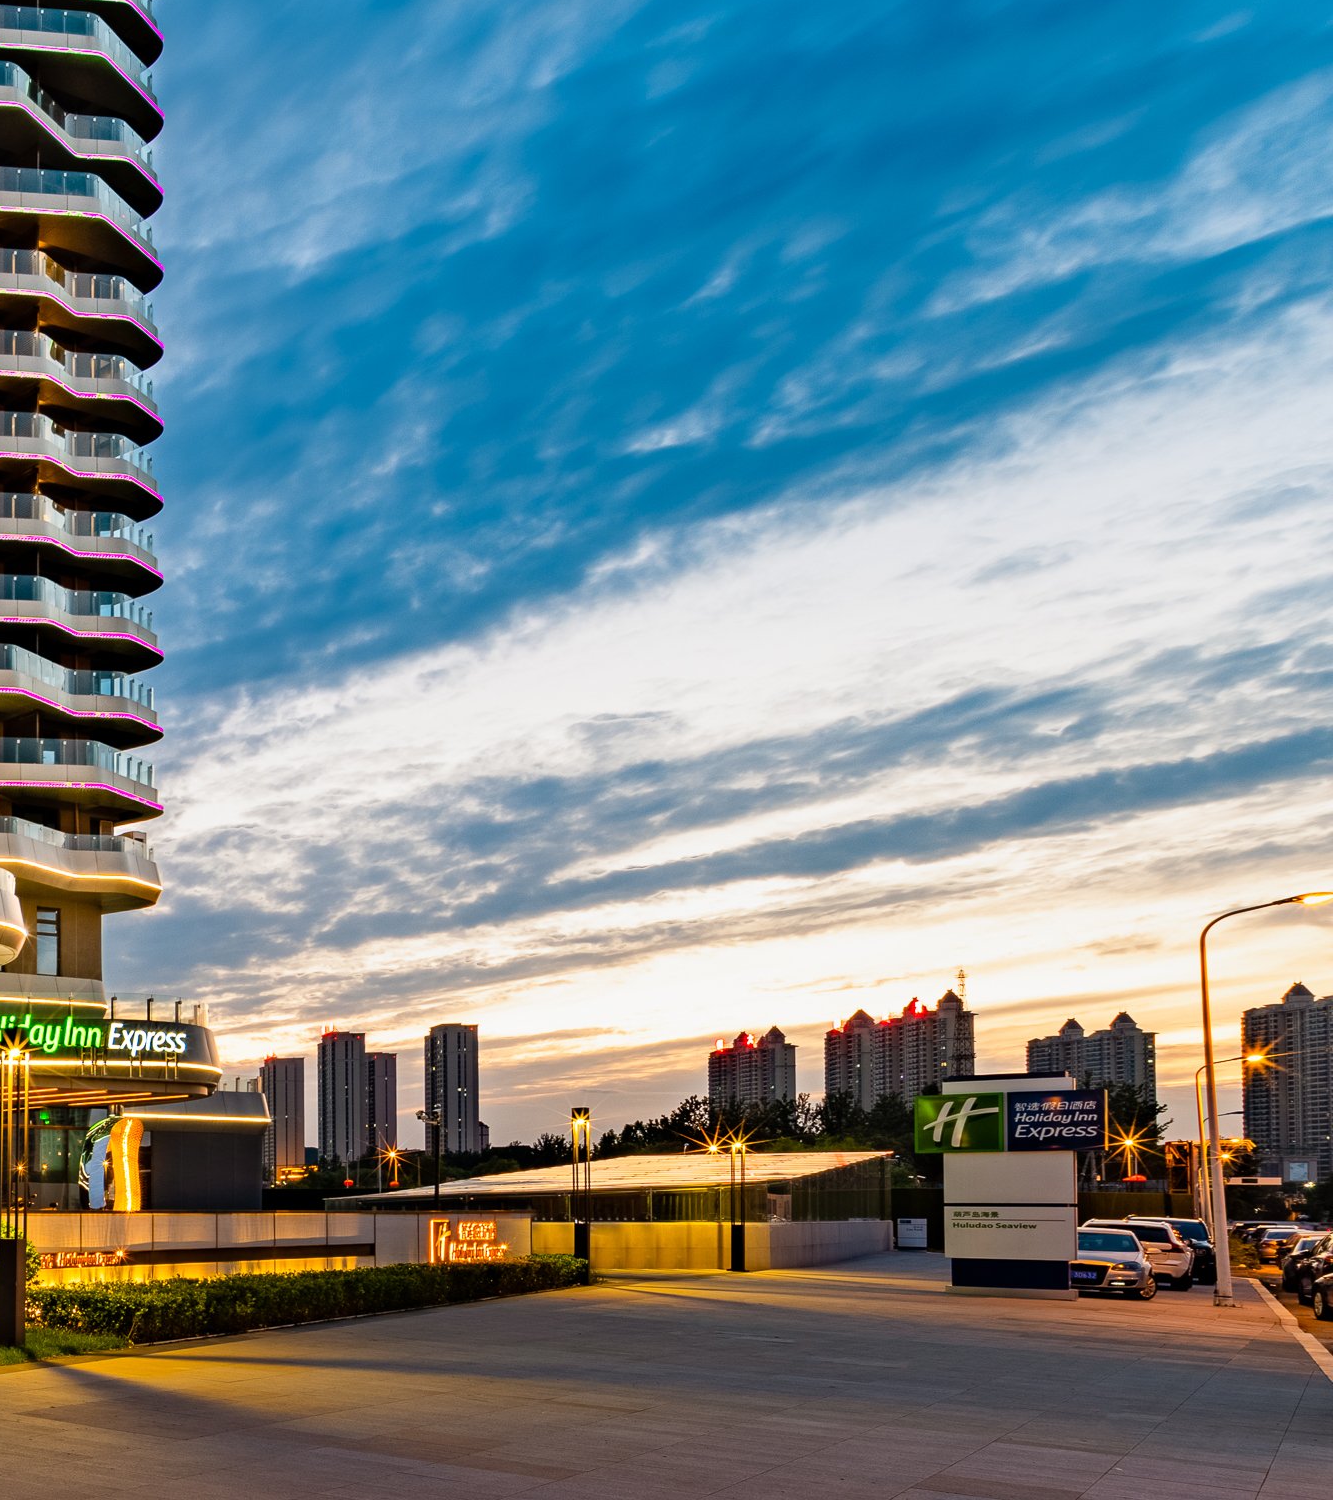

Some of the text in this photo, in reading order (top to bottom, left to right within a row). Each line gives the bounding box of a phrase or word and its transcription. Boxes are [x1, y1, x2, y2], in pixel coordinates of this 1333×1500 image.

[64, 1015, 102, 1048] Inn
[108, 1022, 187, 1057] Express
[1014, 1100, 1097, 1112] 智选假日酒店
[1014, 1111, 1098, 1124] Holiday Inn
[1014, 1124, 1099, 1141] Express
